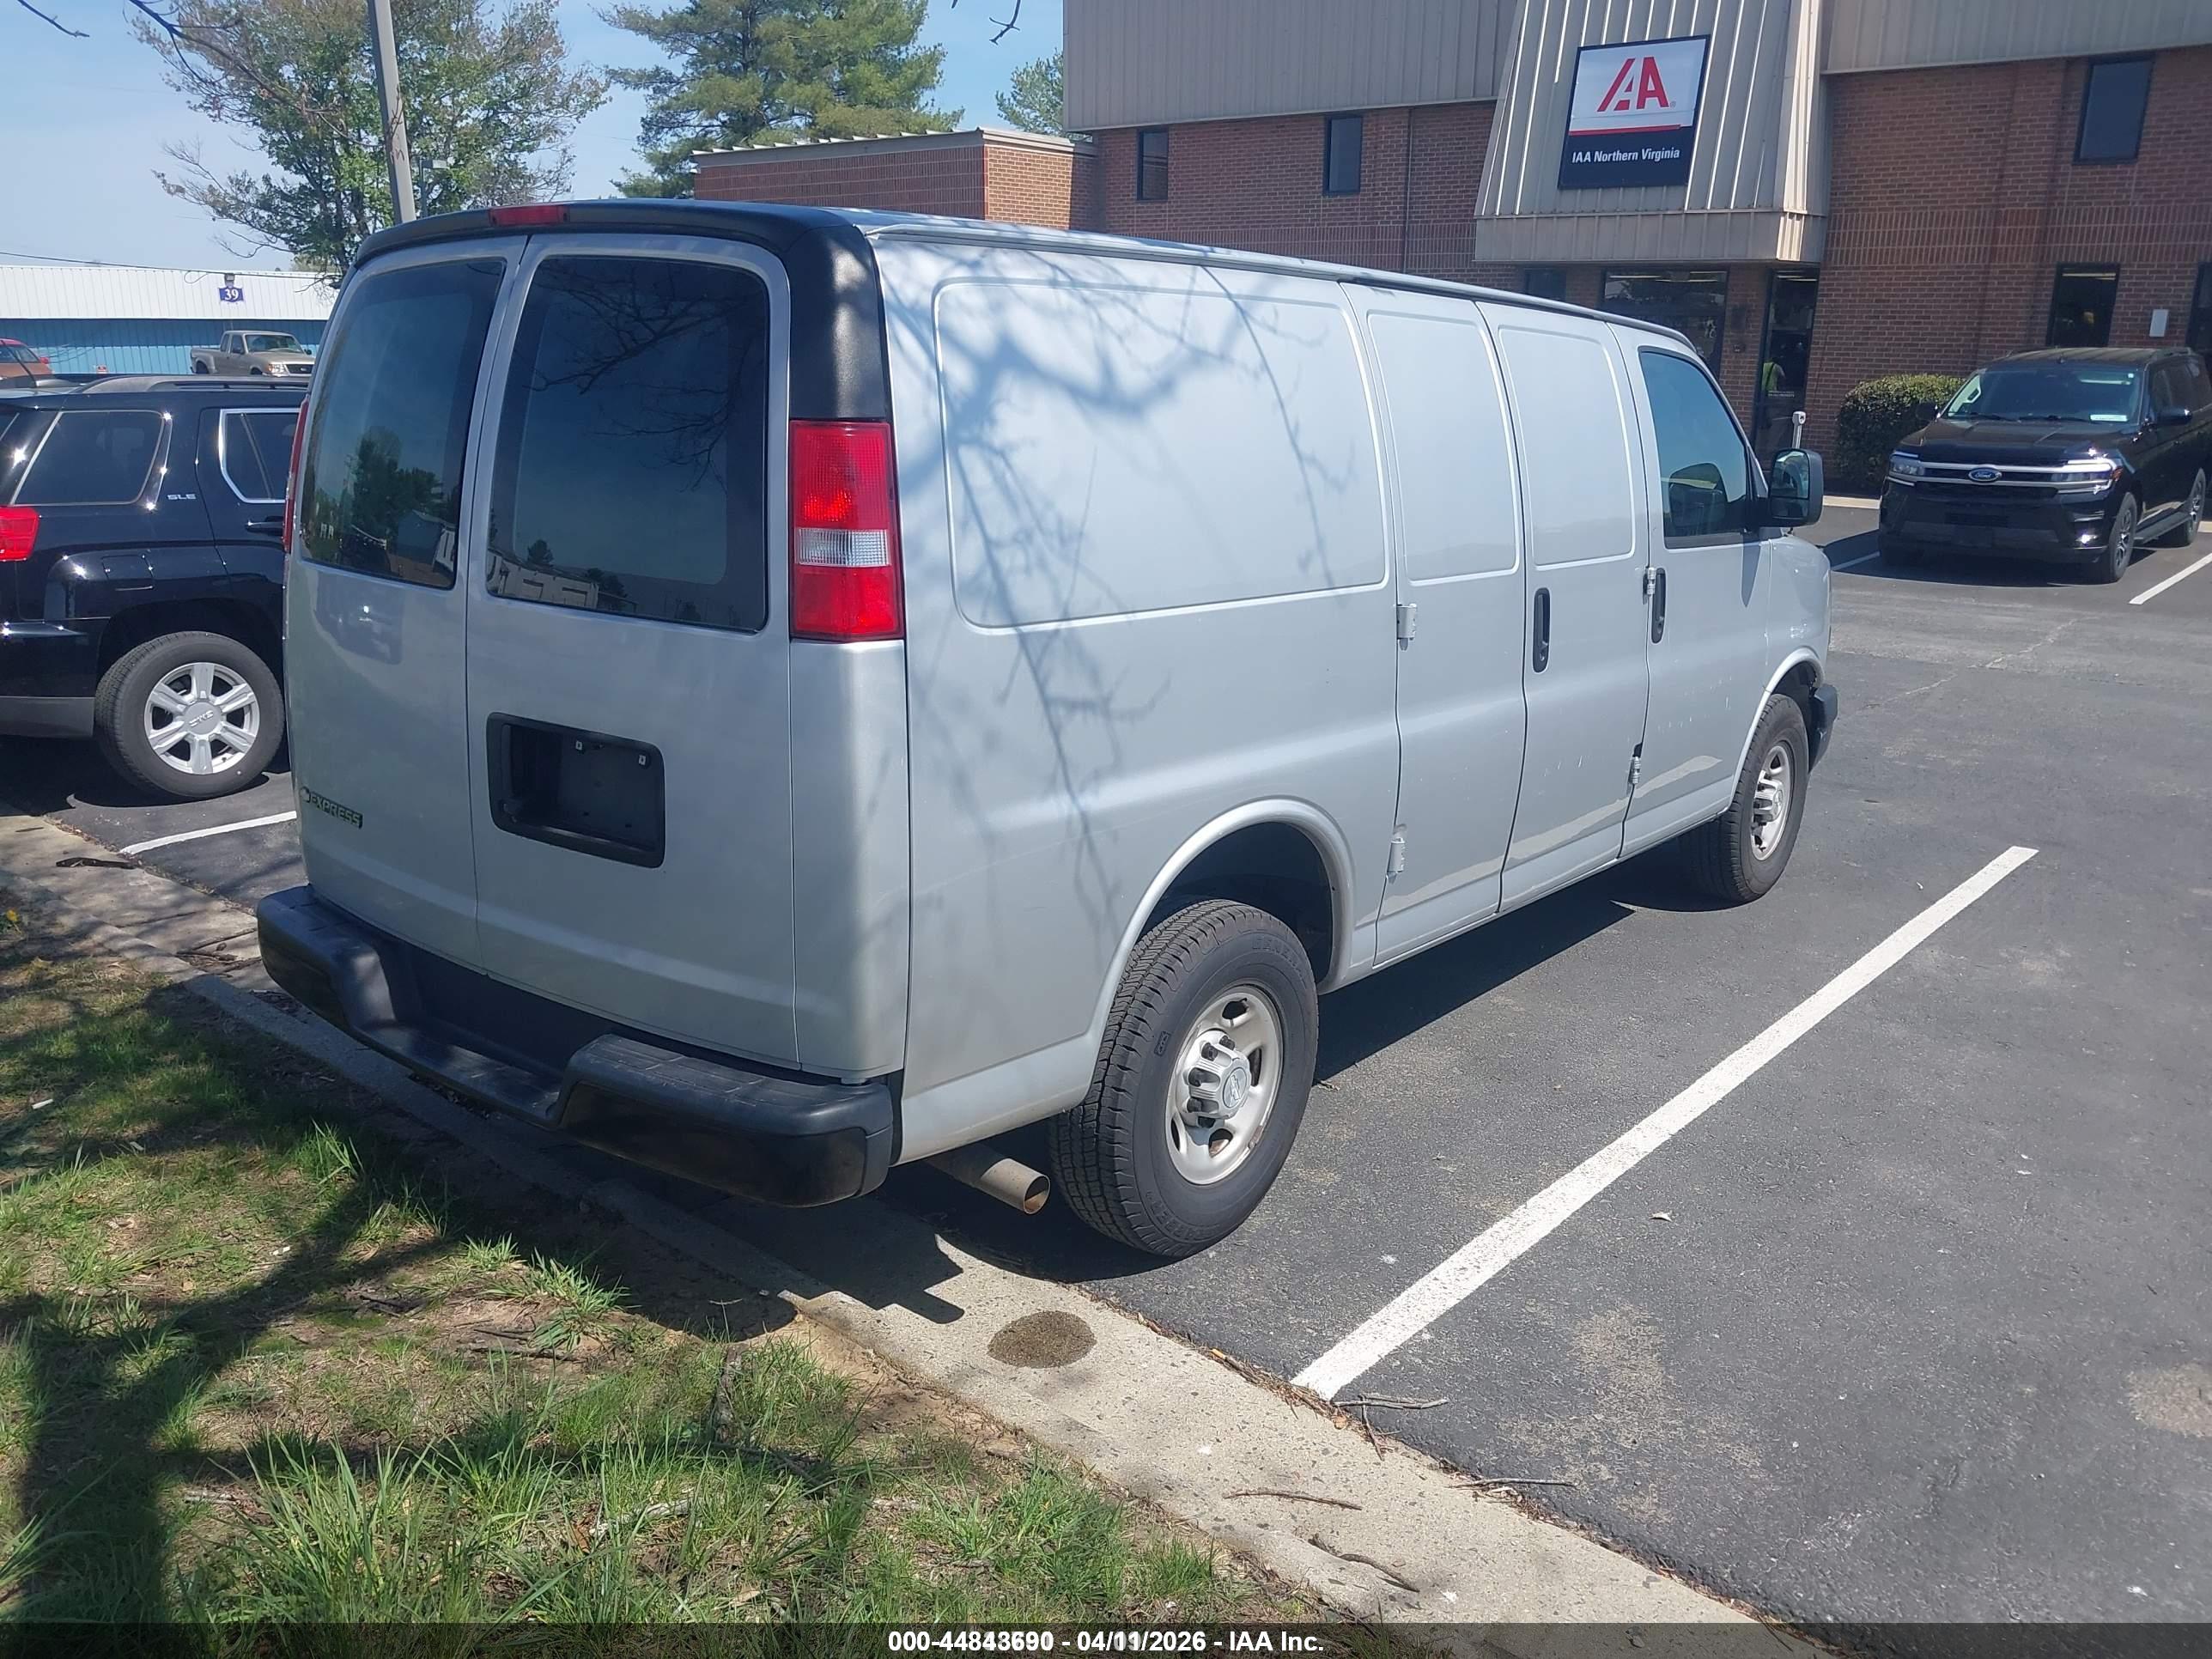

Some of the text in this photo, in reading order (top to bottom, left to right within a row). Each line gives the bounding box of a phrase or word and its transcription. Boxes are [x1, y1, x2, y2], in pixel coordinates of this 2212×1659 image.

[1597, 57, 1669, 112] IAA
[1571, 147, 1680, 163] IAA Northern Virginia
[225, 289, 239, 301] 39
[310, 791, 364, 830] EXPRESS
